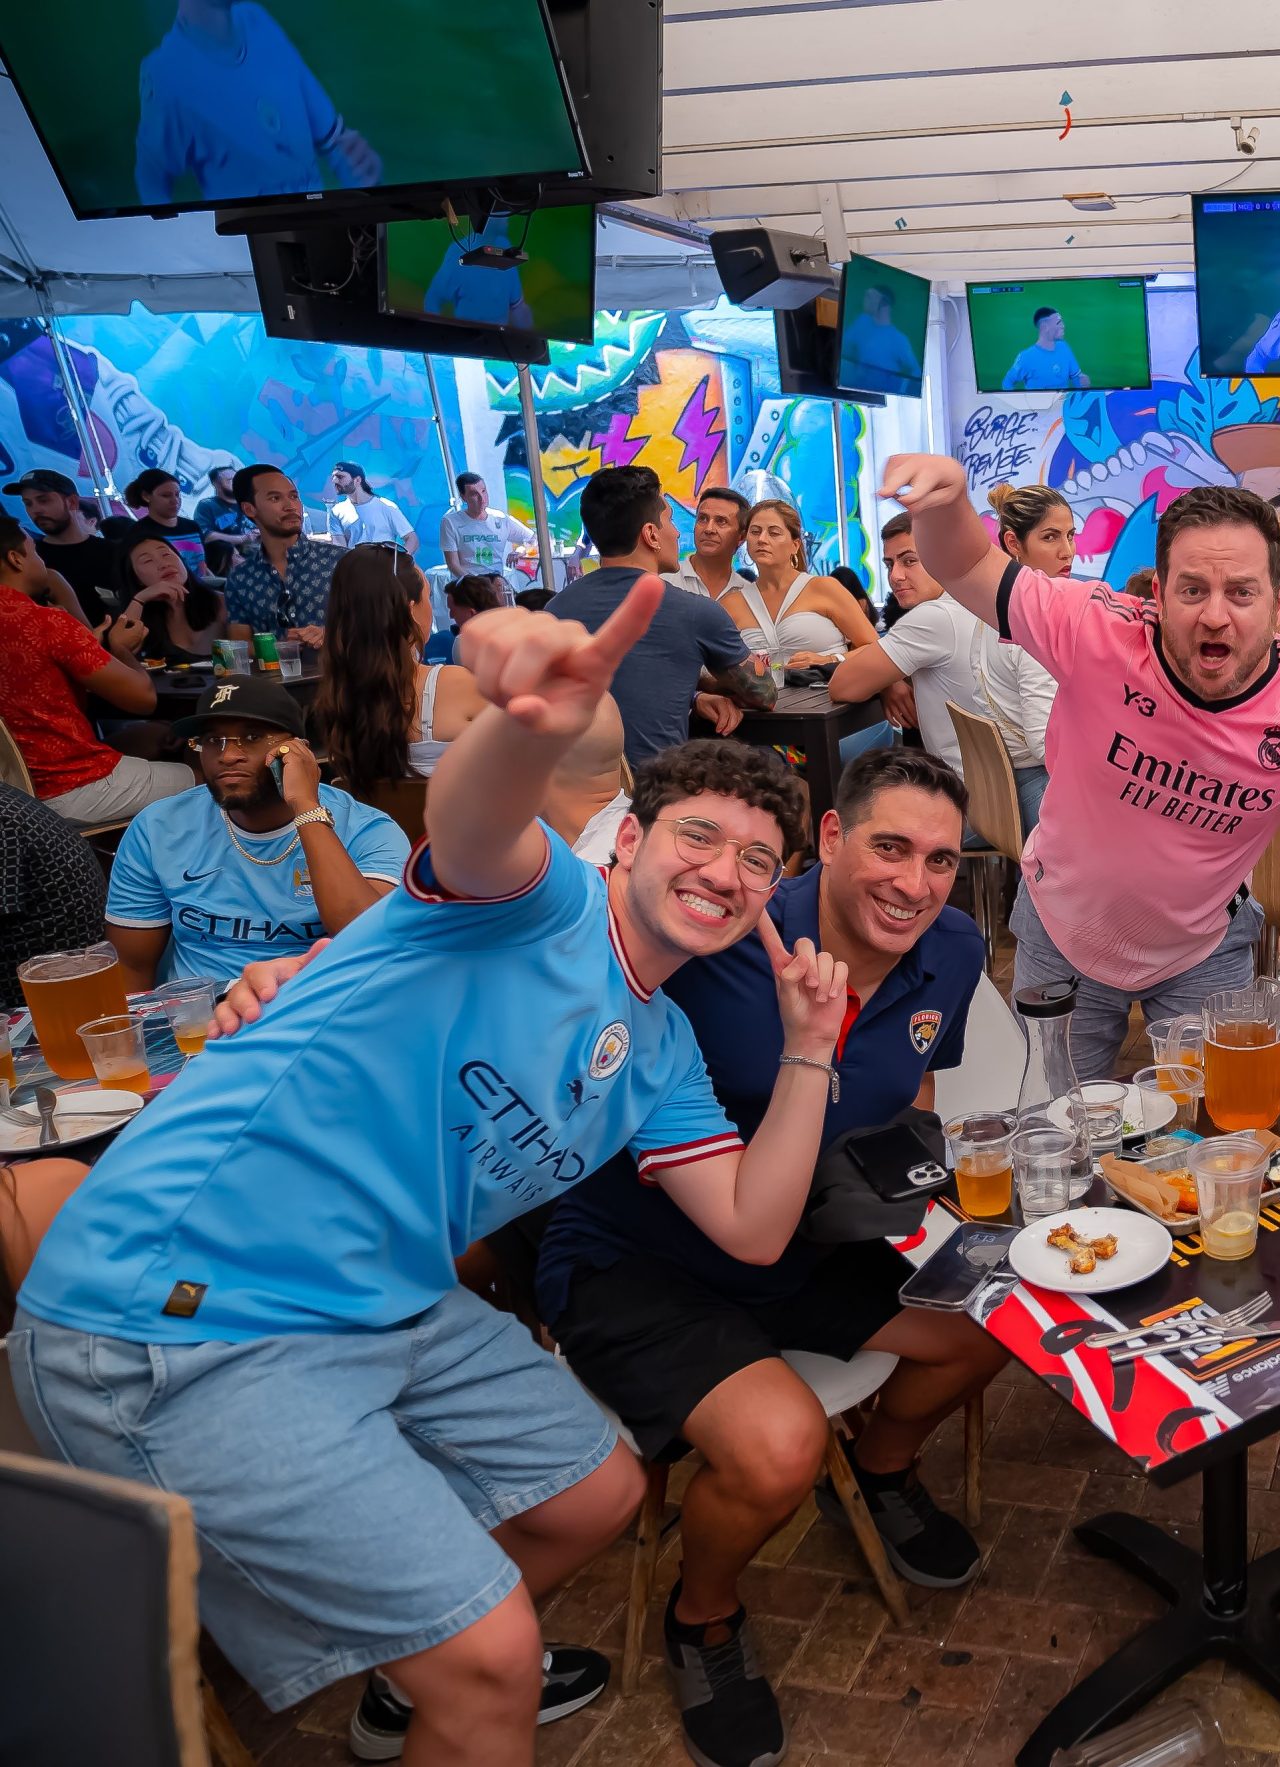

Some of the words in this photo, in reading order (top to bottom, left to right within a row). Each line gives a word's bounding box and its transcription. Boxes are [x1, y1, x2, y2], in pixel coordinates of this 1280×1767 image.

[463, 534, 501, 543] BRASIL
[1123, 682, 1158, 718] Y-3
[1106, 731, 1276, 812] Emirates
[1119, 781, 1160, 810] FLY
[1161, 796, 1243, 835] BETTER
[914, 1014, 939, 1022] FLORIDA
[459, 1060, 585, 1182] ETIHAD
[449, 1123, 543, 1201] AIRWAYS
